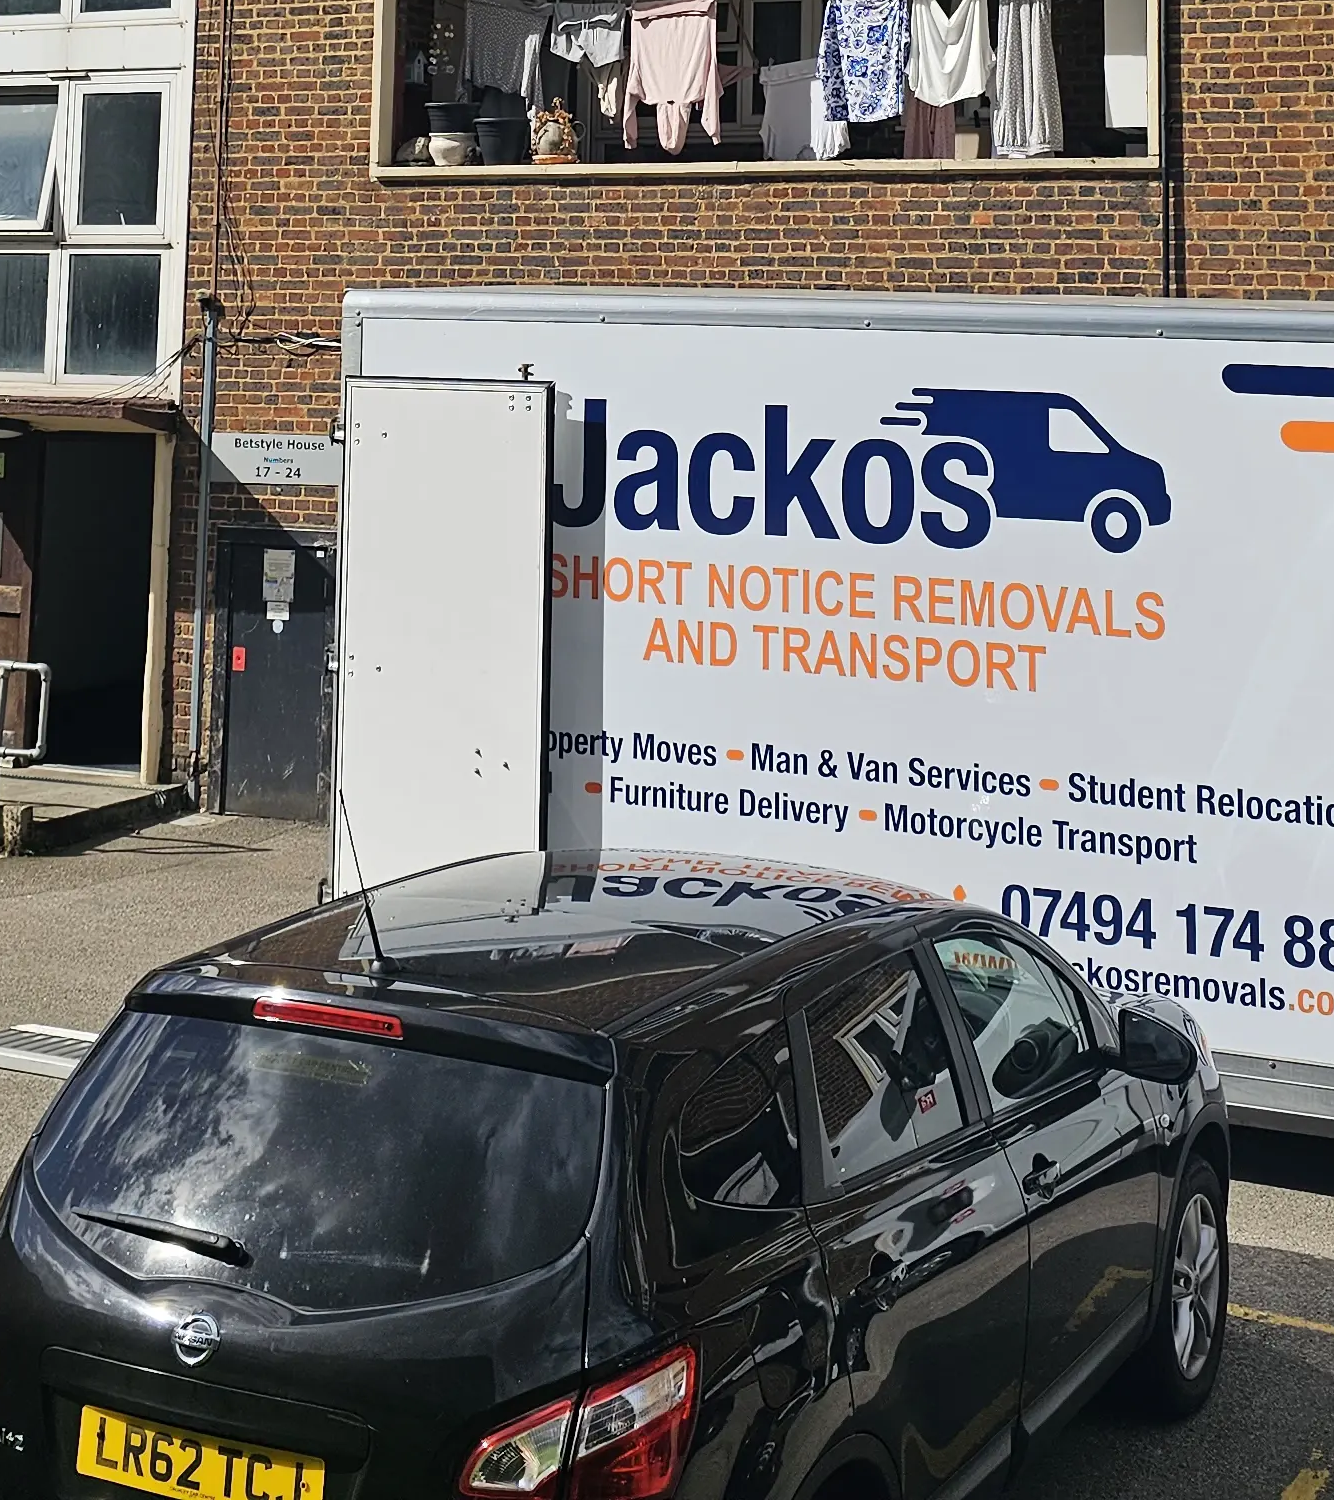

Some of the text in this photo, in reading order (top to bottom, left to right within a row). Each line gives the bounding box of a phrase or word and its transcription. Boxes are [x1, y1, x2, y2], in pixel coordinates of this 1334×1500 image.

[234, 437, 325, 452] Betstyle House
[255, 466, 271, 478] 17
[285, 466, 302, 479] 24
[263, 456, 294, 464] Numbers
[551, 398, 992, 549] Jackos
[552, 553, 1166, 641] SHORT NOTICE REMOVALS
[645, 619, 1047, 692] AND TRANSPORT
[550, 731, 624, 764] operty
[633, 733, 716, 766] Moves
[752, 743, 807, 775] Man
[818, 750, 838, 778] &
[847, 752, 897, 784] Van
[909, 758, 1030, 797] Services
[1069, 773, 1186, 812] Student
[610, 776, 1197, 865] Furniture Delivery Motorcycle Transport
[1001, 884, 1157, 950] 07494
[1176, 904, 1264, 962] 174
[95, 1417, 203, 1490] LR62
